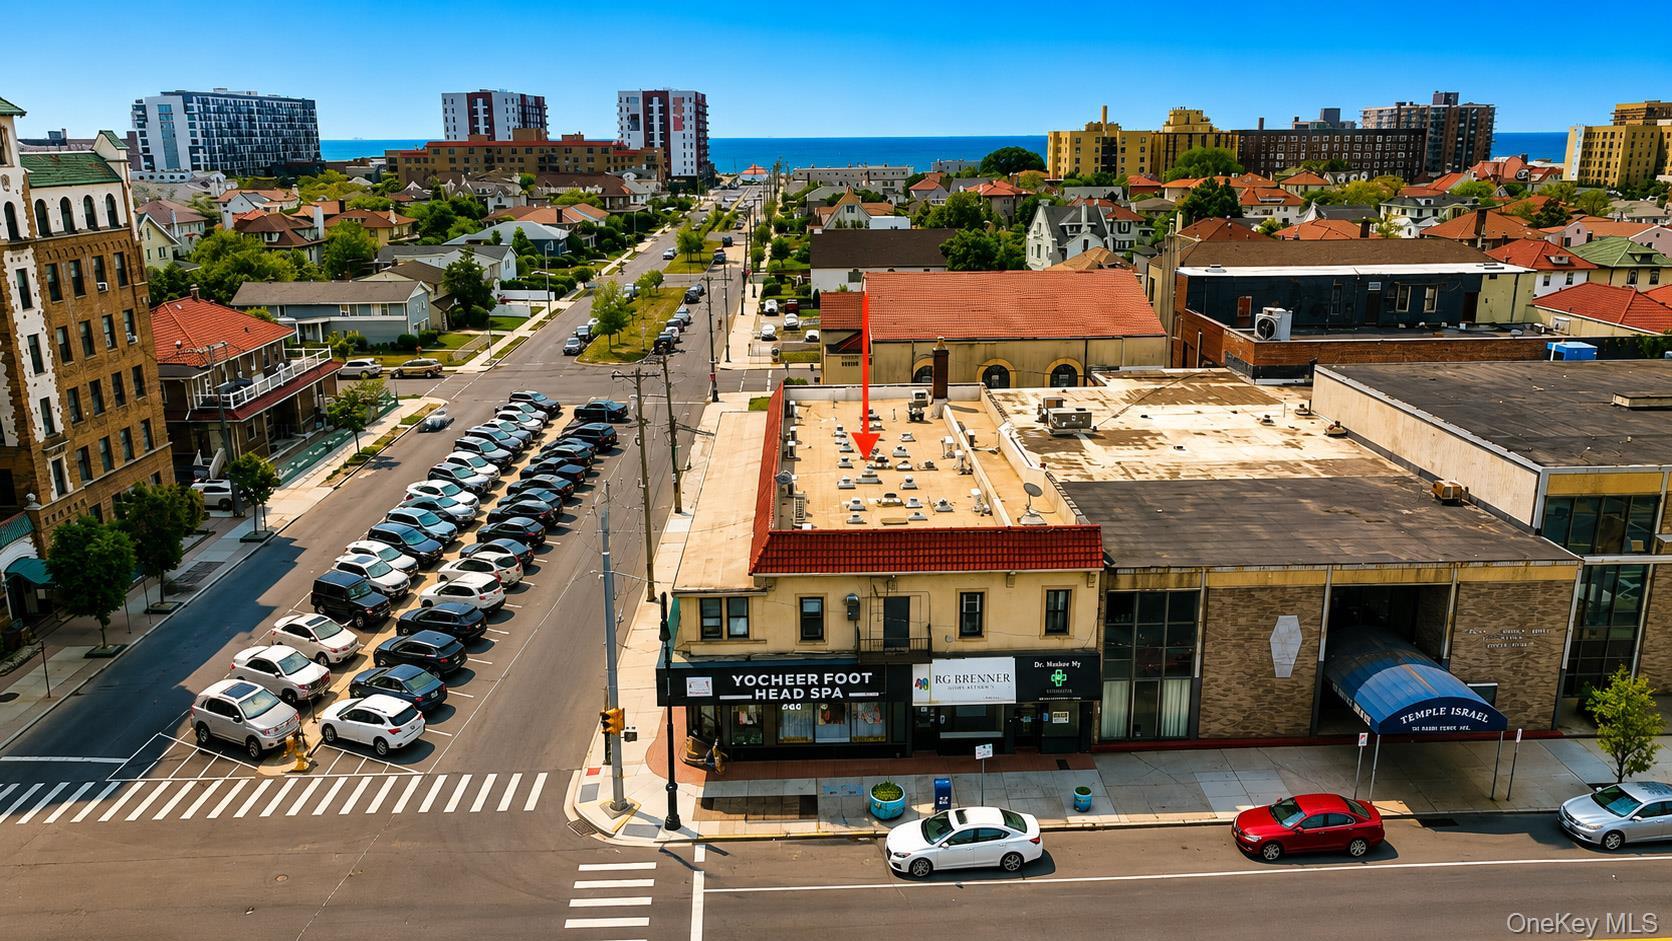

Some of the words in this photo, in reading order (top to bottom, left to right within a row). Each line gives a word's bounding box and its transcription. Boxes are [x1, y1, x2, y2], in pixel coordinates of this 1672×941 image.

[732, 674, 818, 687] YOCHEER
[824, 672, 873, 684] FOOT
[935, 674, 951, 685] RG
[954, 673, 1011, 684] BRENNER
[755, 688, 805, 700] HEAD
[810, 687, 843, 699] SPA
[1400, 707, 1447, 725] TEMPLE
[1450, 707, 1489, 723] ISRAEL
